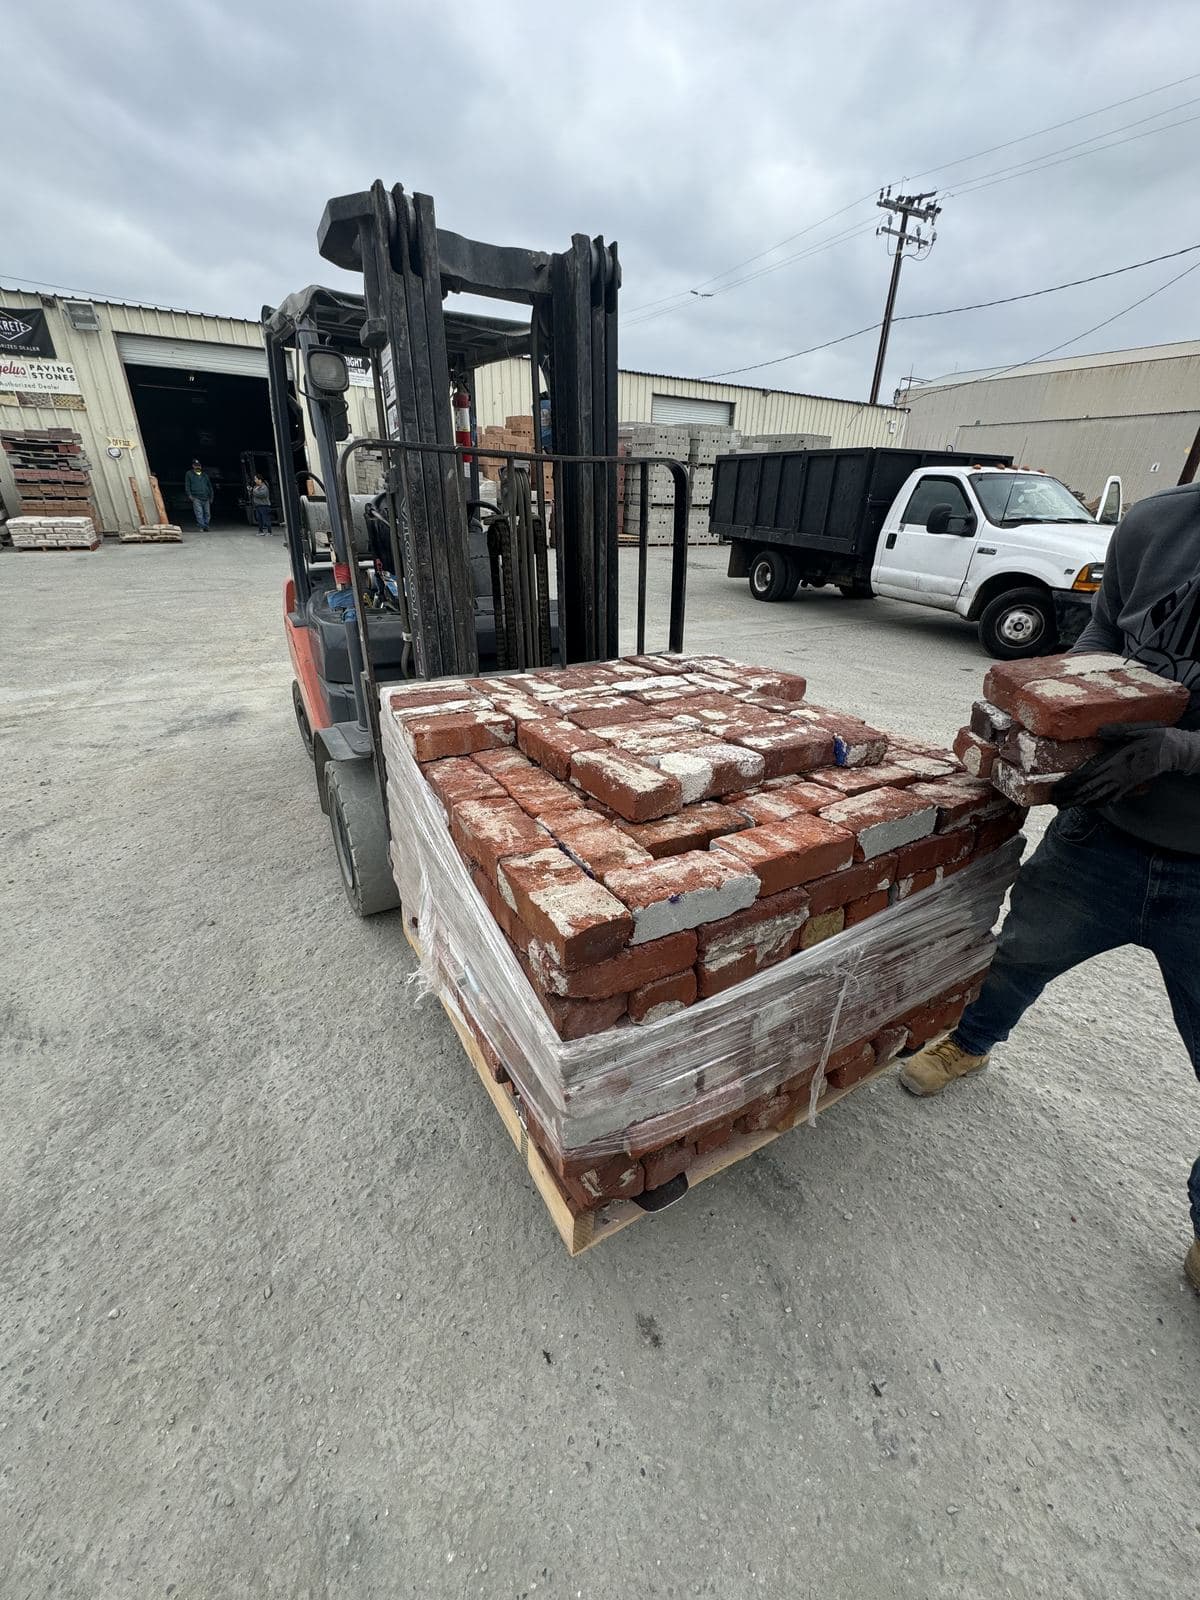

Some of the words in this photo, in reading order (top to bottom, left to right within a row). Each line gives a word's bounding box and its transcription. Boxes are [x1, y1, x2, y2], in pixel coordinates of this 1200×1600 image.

[29, 364, 73, 373] PAVING
[31, 373, 75, 381] STONES
[400, 497, 419, 621] TOYOTA
